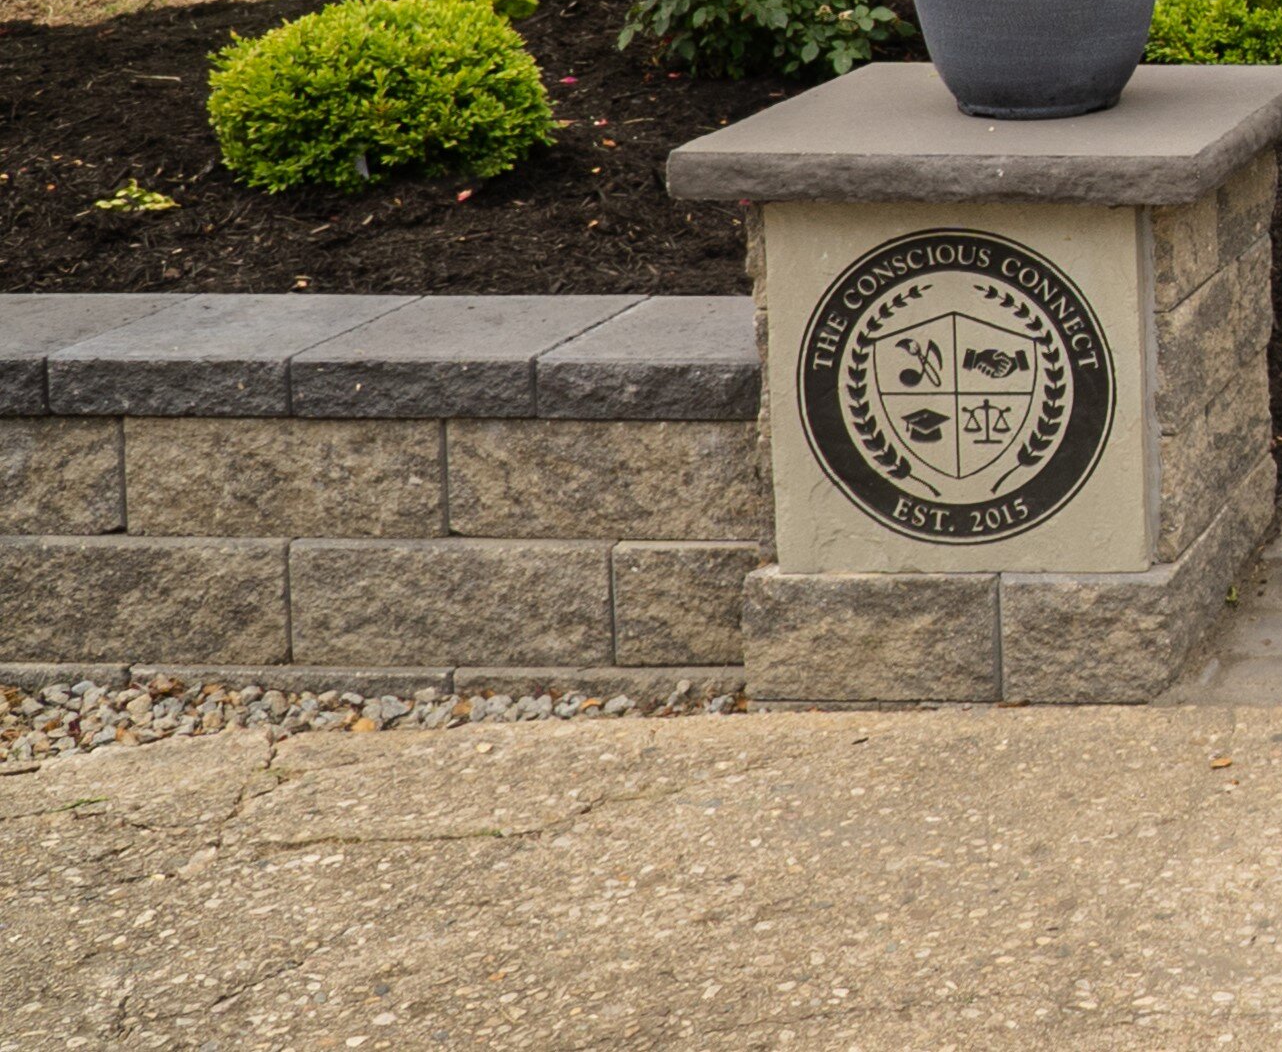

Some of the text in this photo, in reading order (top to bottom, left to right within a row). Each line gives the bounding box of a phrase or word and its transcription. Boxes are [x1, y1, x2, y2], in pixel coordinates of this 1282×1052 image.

[811, 243, 1101, 370] THE CONSCIOUS CONNECT
[892, 497, 1030, 533] EST. 2015
